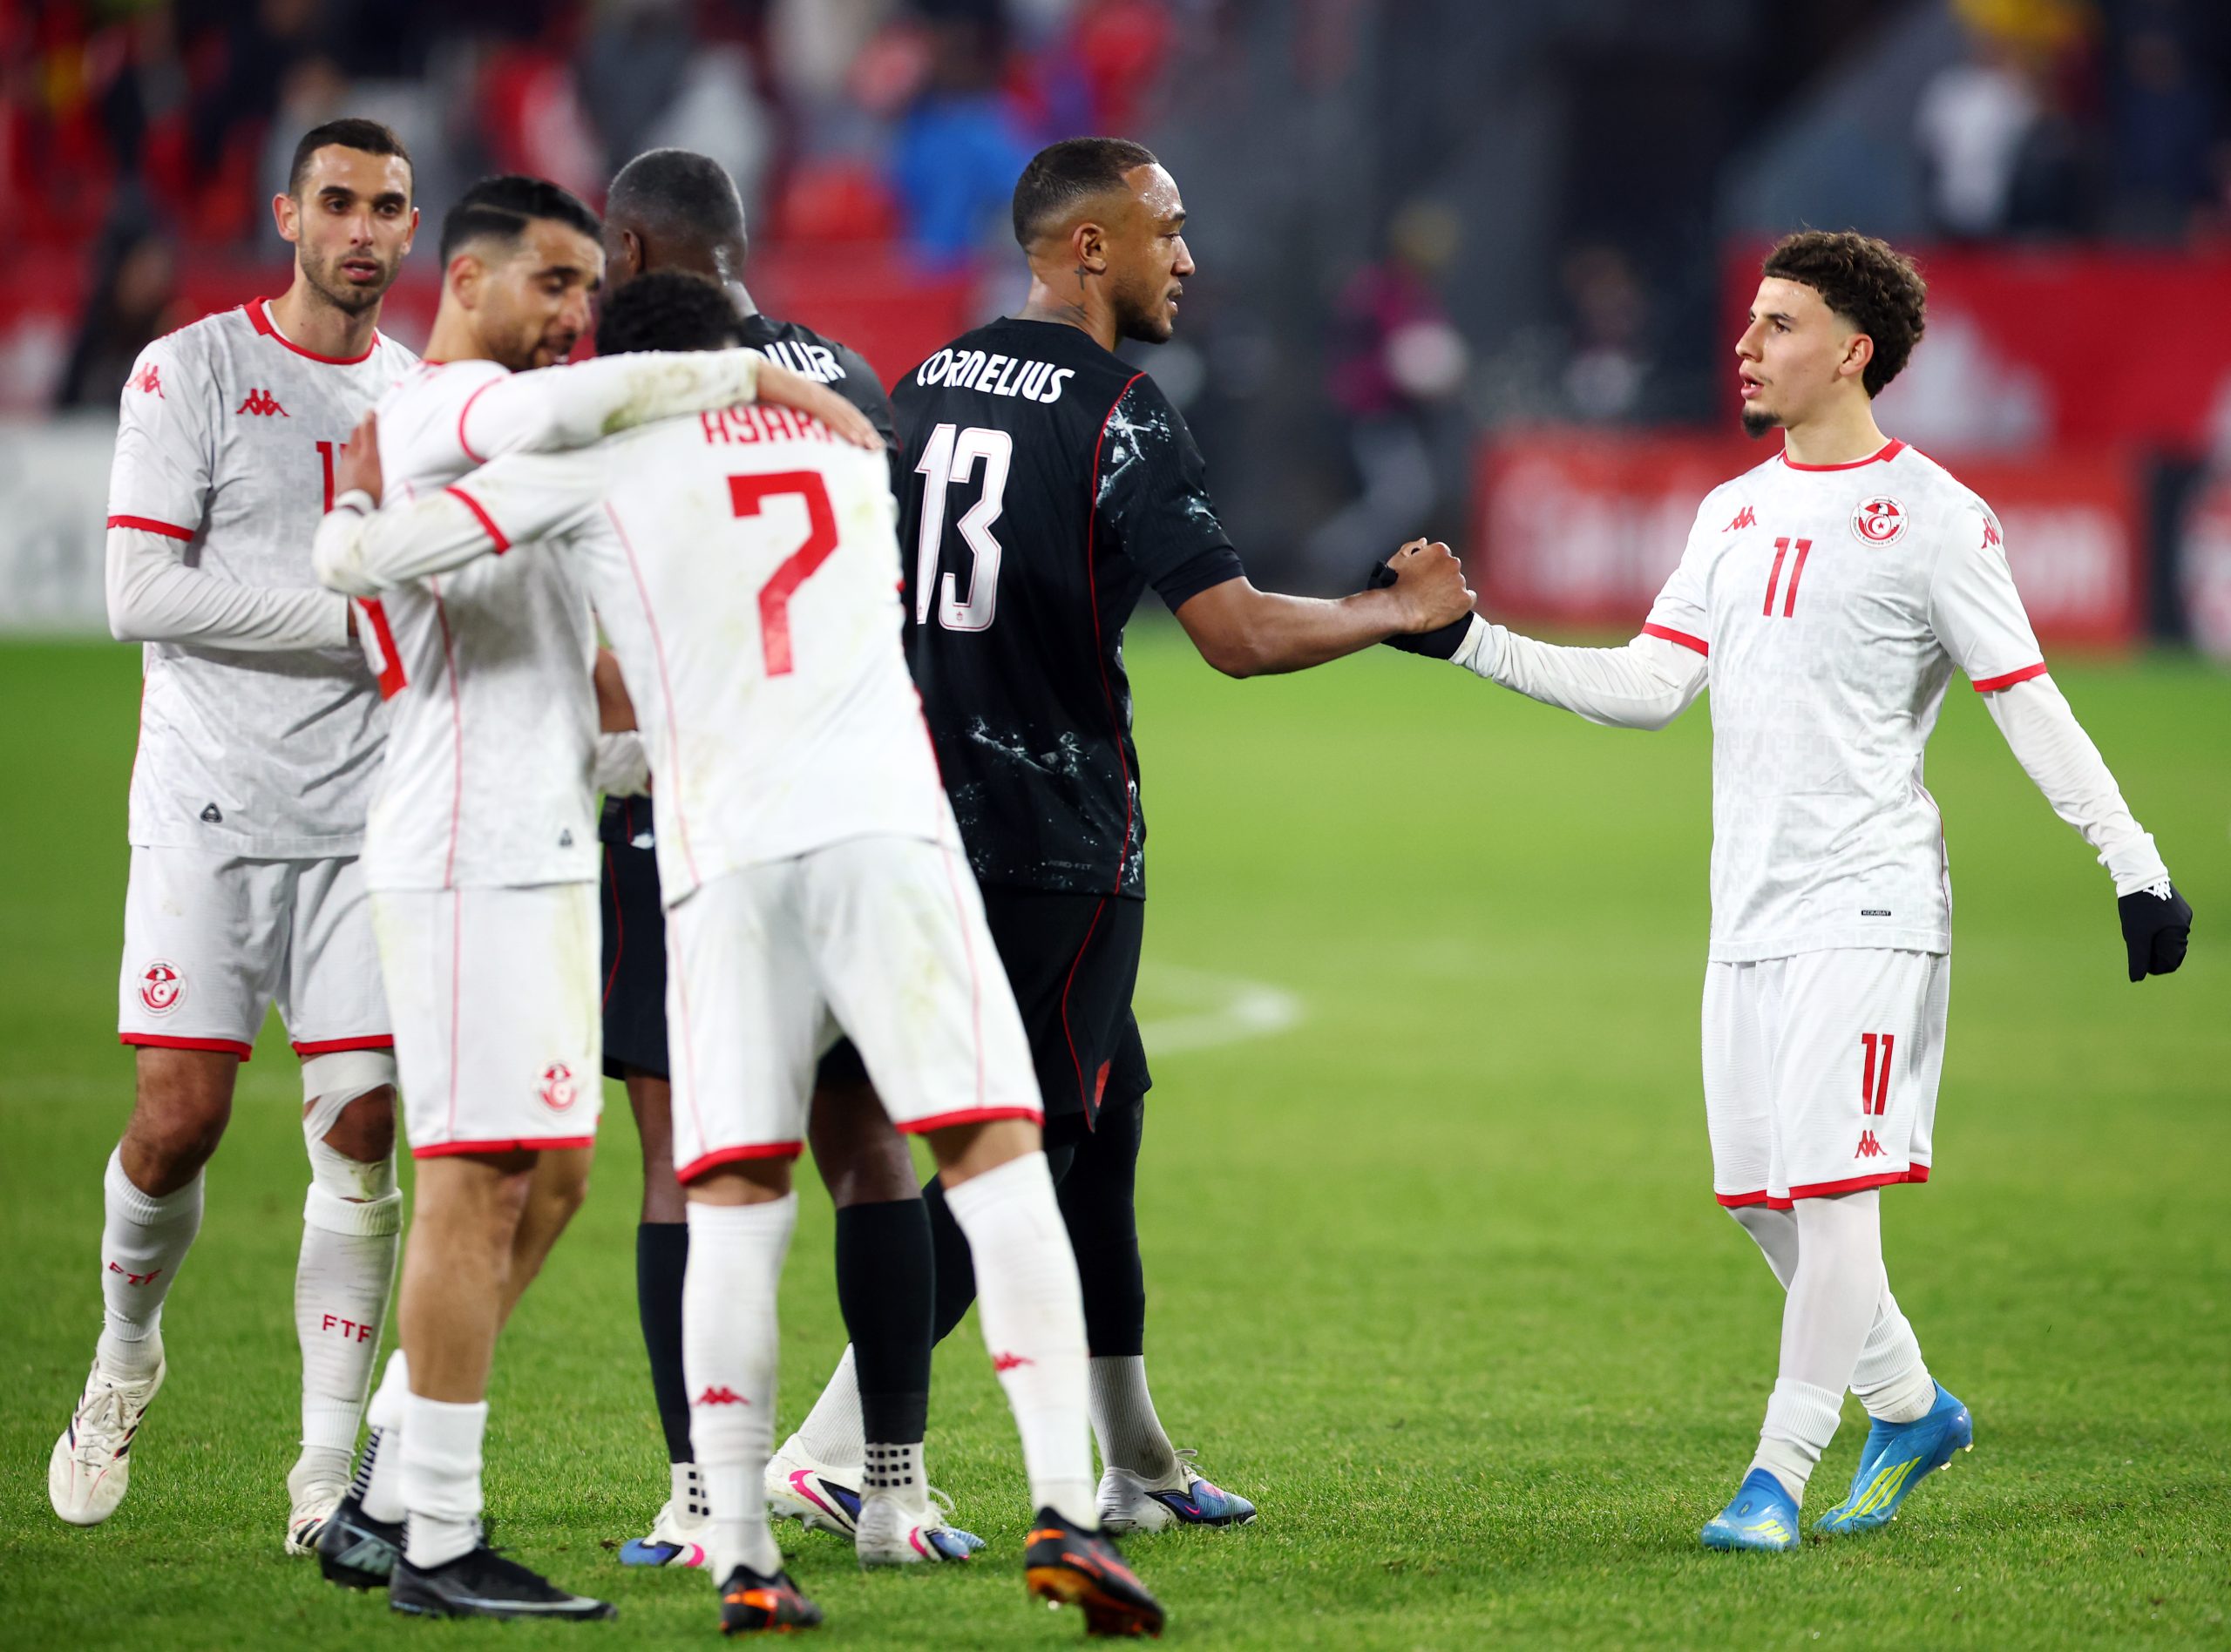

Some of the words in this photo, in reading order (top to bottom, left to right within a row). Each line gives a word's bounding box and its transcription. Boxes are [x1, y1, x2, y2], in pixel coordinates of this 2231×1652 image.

[916, 348, 1075, 404] CORNELIUS
[914, 423, 1014, 633] 13
[726, 469, 839, 678] 7
[1762, 537, 1813, 618] 11
[1861, 1033, 1895, 1115] 11
[109, 1262, 163, 1285] FTF
[322, 1314, 373, 1343] FTF
